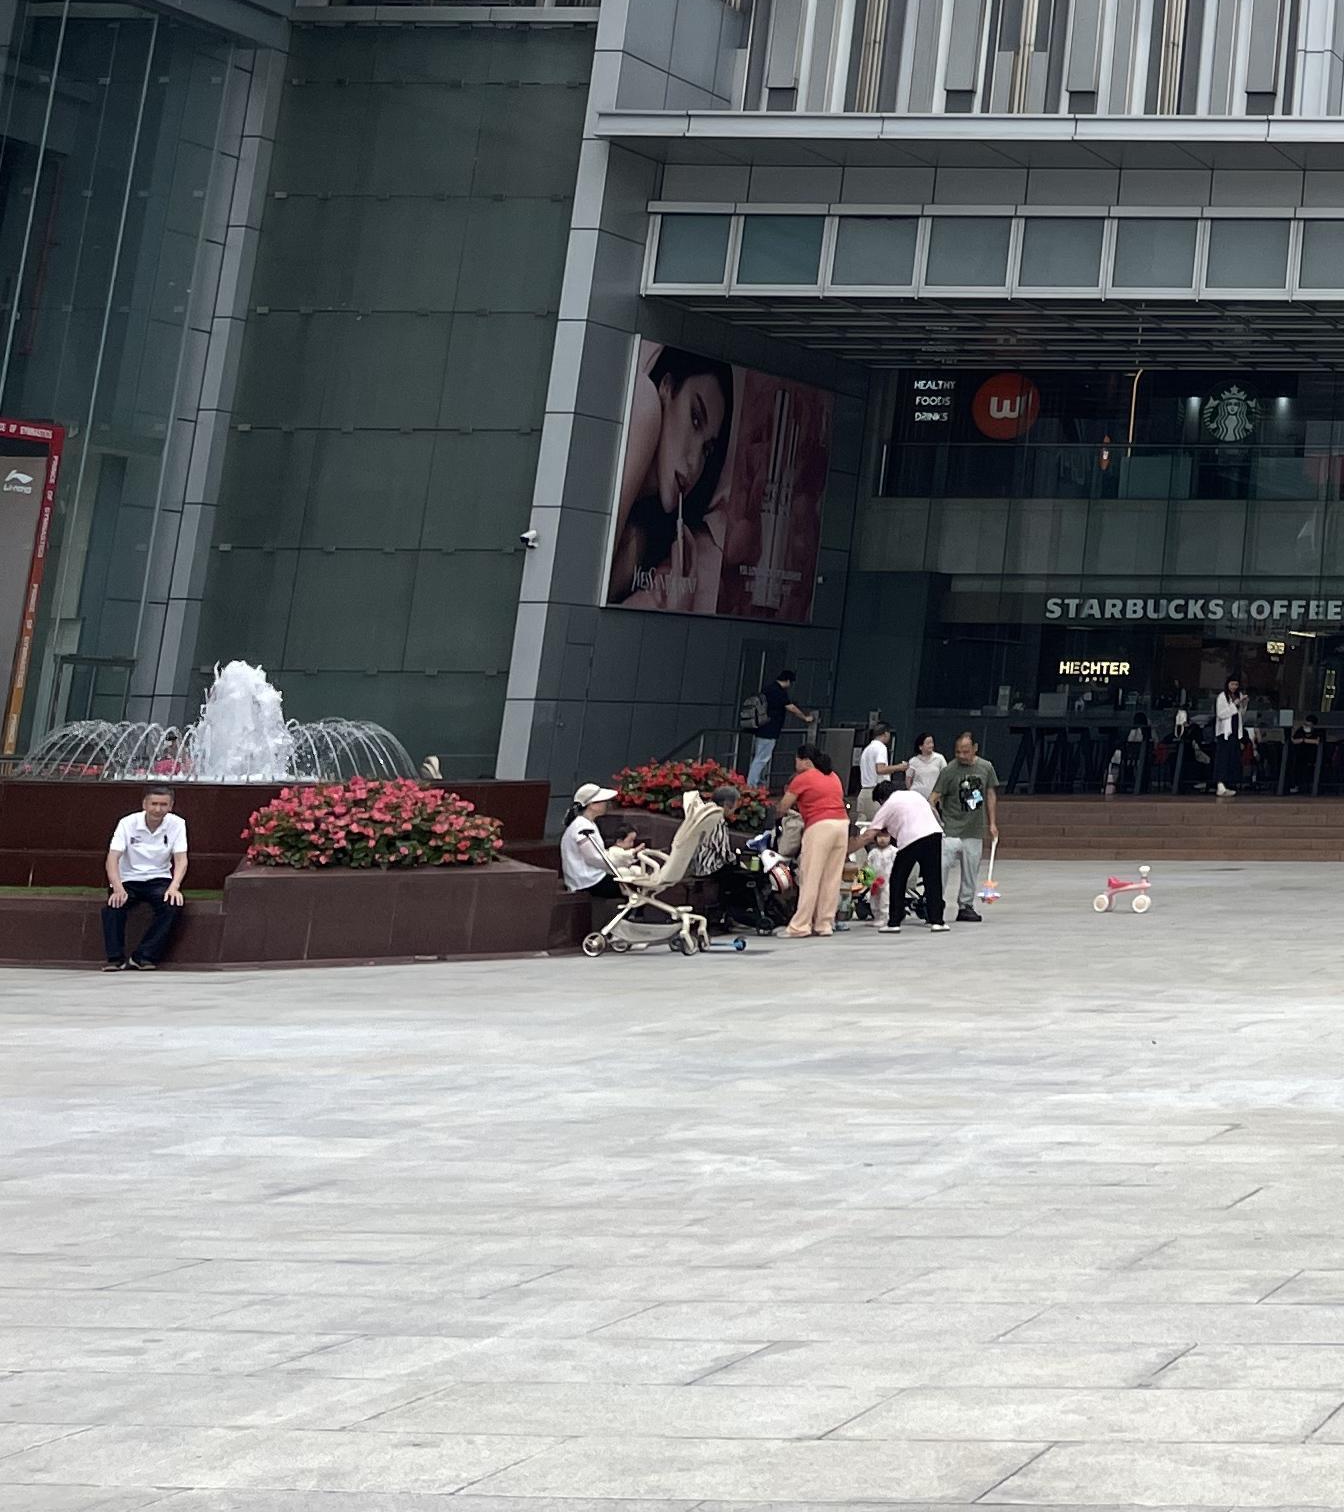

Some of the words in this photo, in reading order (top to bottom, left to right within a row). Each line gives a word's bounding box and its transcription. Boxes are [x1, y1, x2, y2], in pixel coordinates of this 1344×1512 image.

[914, 380, 956, 390] HEALTHY
[915, 396, 951, 406] FOODS
[1045, 597, 1224, 620] STARBUCKS
[1231, 599, 1343, 620] COFFEE
[1059, 661, 1130, 675] HECHTER
